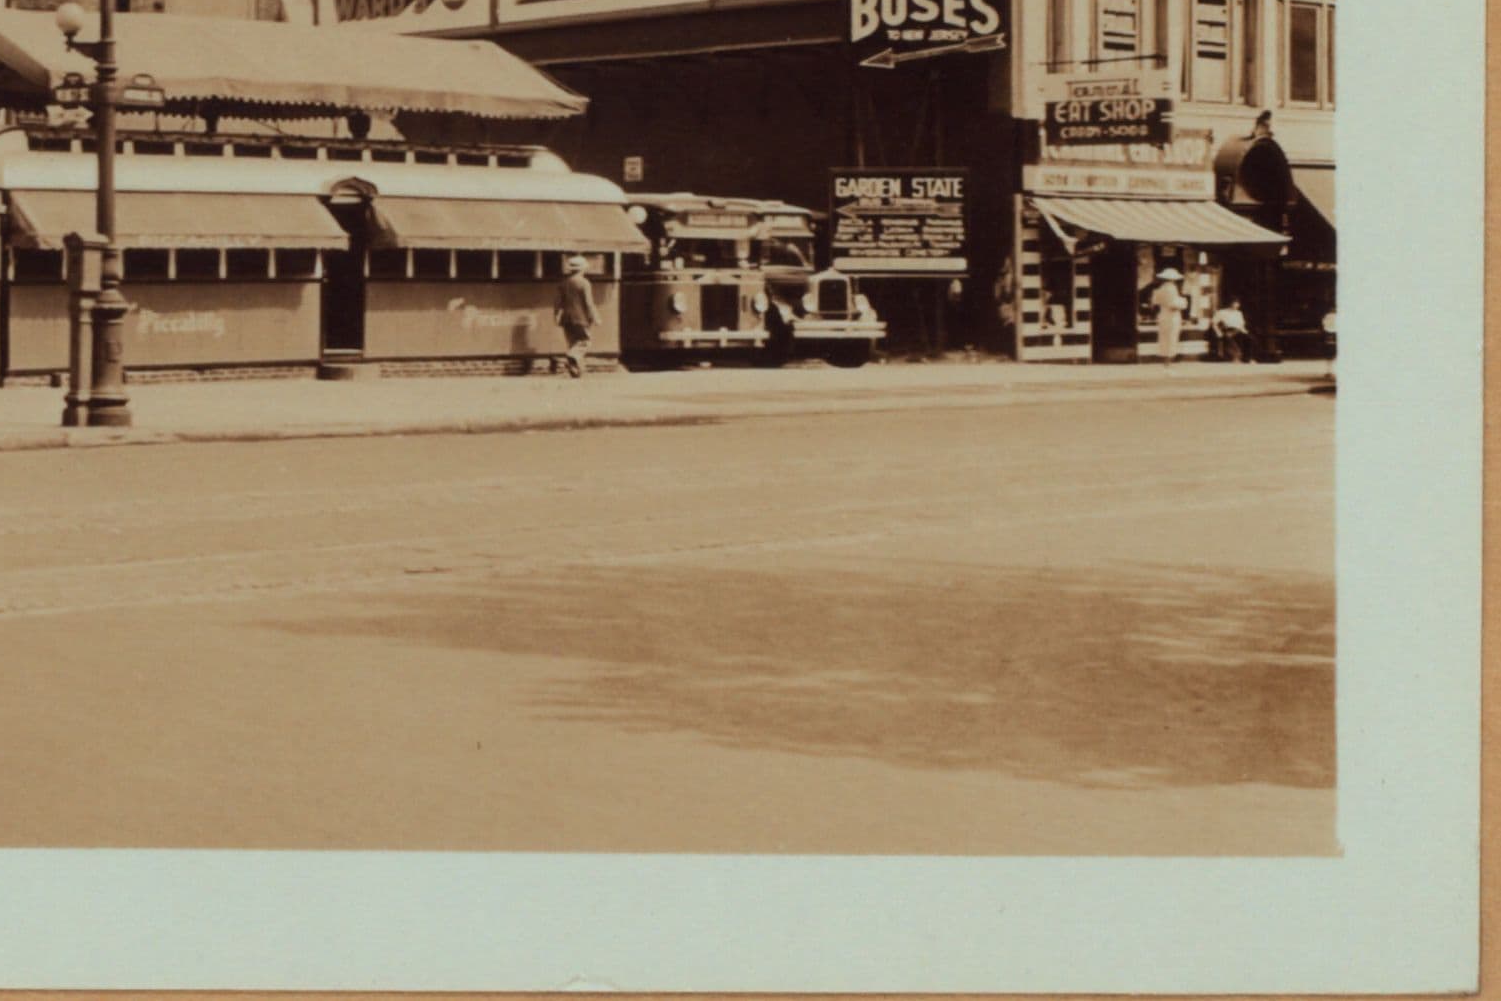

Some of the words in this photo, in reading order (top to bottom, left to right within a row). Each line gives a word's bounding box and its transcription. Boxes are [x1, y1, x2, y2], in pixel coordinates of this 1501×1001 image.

[1054, 101, 1092, 123] EAT
[1099, 99, 1156, 121] SHOP
[835, 177, 902, 198] GARDEN
[911, 177, 964, 198] STATE
